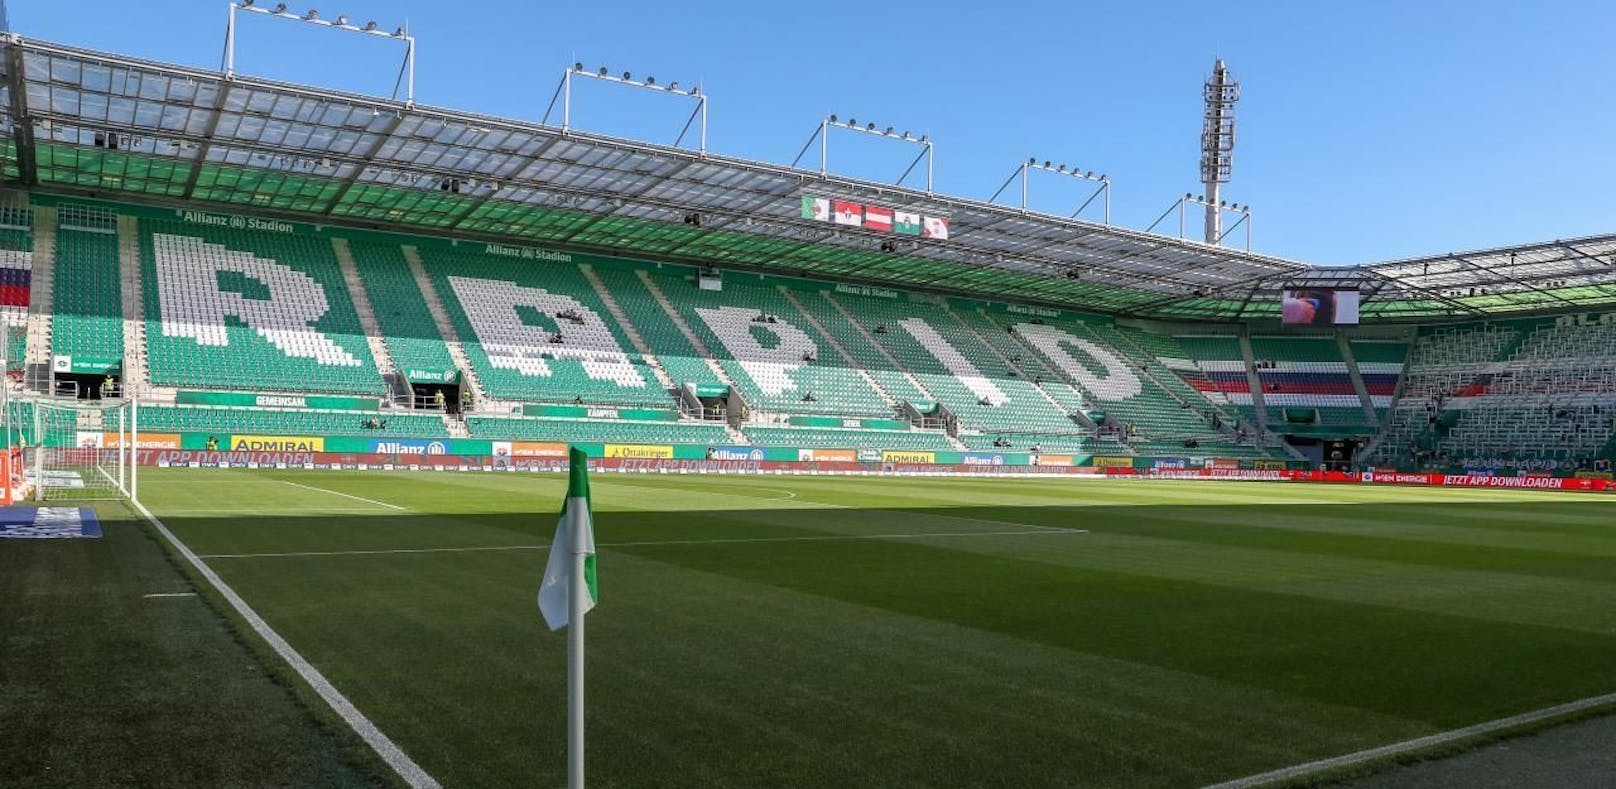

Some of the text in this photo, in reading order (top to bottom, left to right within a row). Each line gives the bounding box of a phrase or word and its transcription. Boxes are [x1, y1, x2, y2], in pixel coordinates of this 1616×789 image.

[183, 211, 293, 233] Allianz Stadion
[485, 244, 572, 263] Allianz Stadion
[409, 370, 443, 380] Allianz
[235, 439, 314, 452] ADMIRAL
[375, 441, 425, 454] Allianz
[156, 450, 193, 465] APP
[197, 451, 314, 465] DOWNLOADEN
[622, 447, 668, 460] Ottakringer
[713, 450, 748, 460] Allianz
[1443, 474, 1563, 489] JETZT APP DOWNLOADEN
